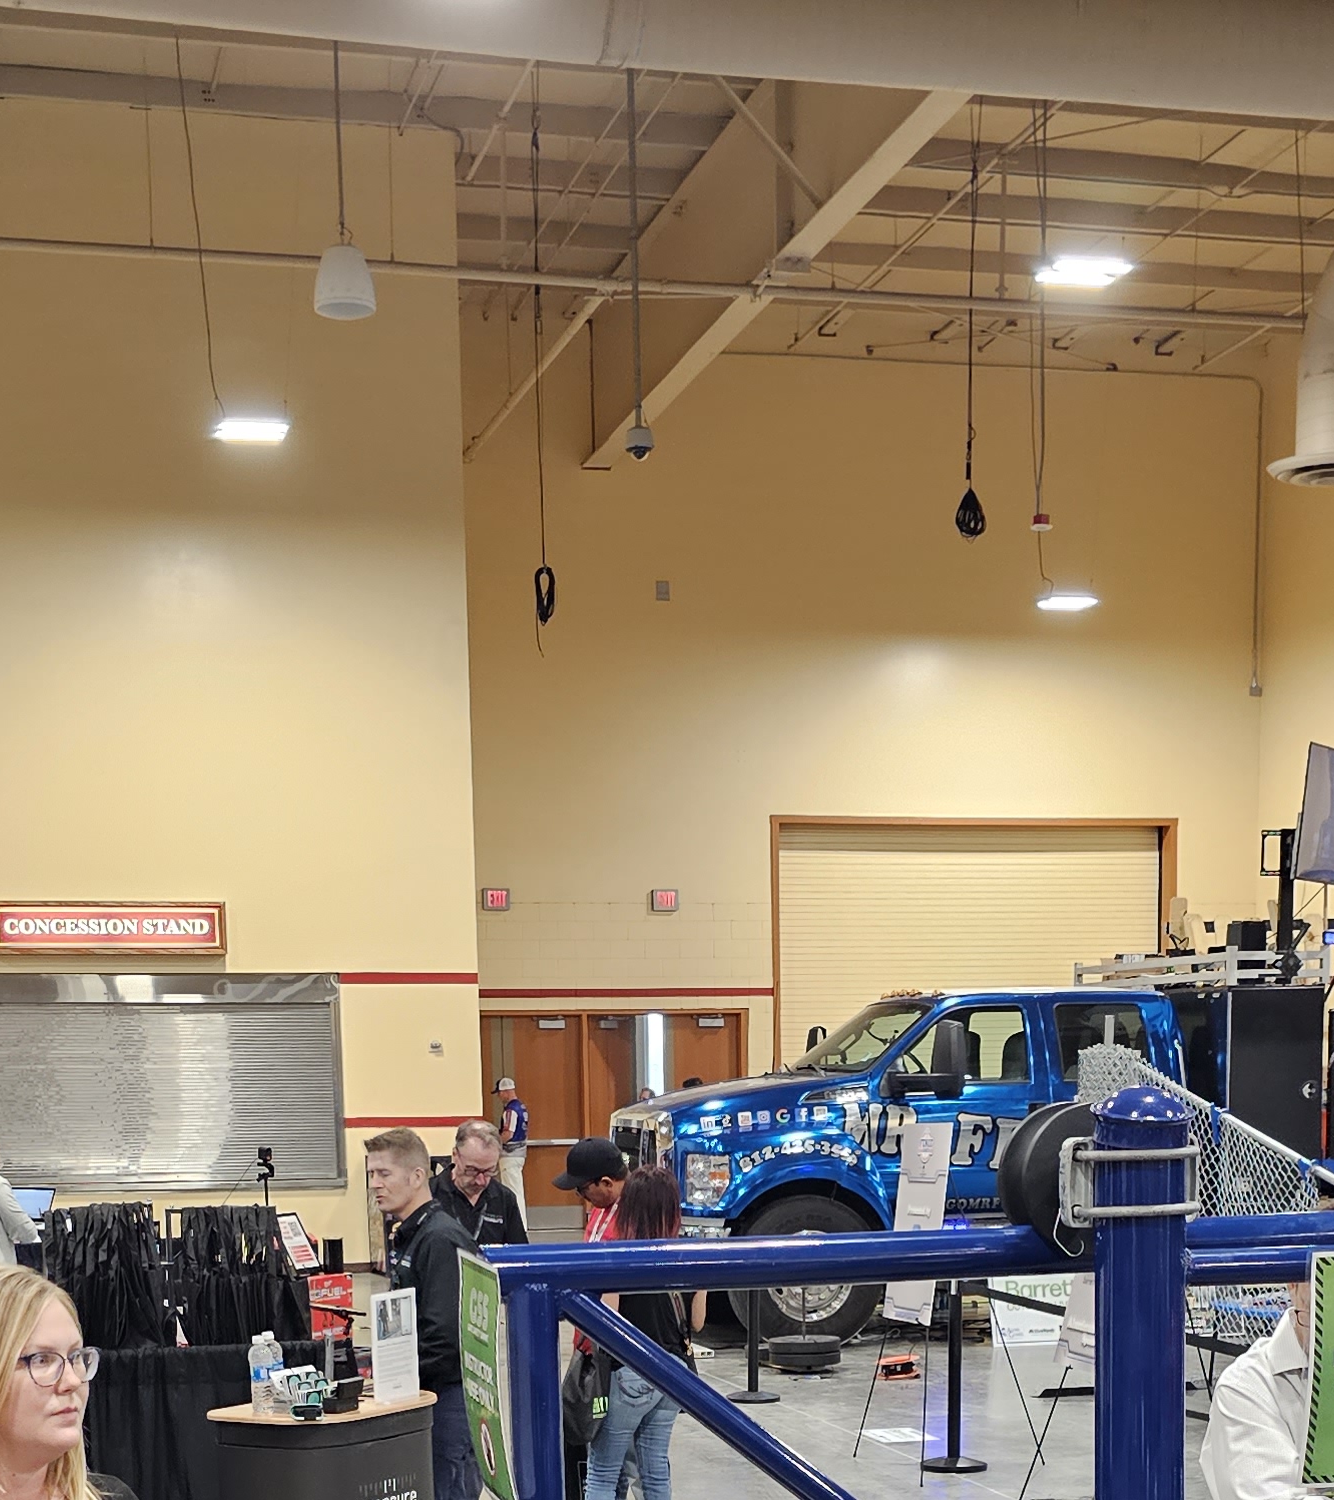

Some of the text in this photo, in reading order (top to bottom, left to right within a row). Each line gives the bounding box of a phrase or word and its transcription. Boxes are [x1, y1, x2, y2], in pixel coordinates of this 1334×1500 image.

[487, 890, 507, 907] EXIT
[3, 918, 210, 935] CONCESSION STAND
